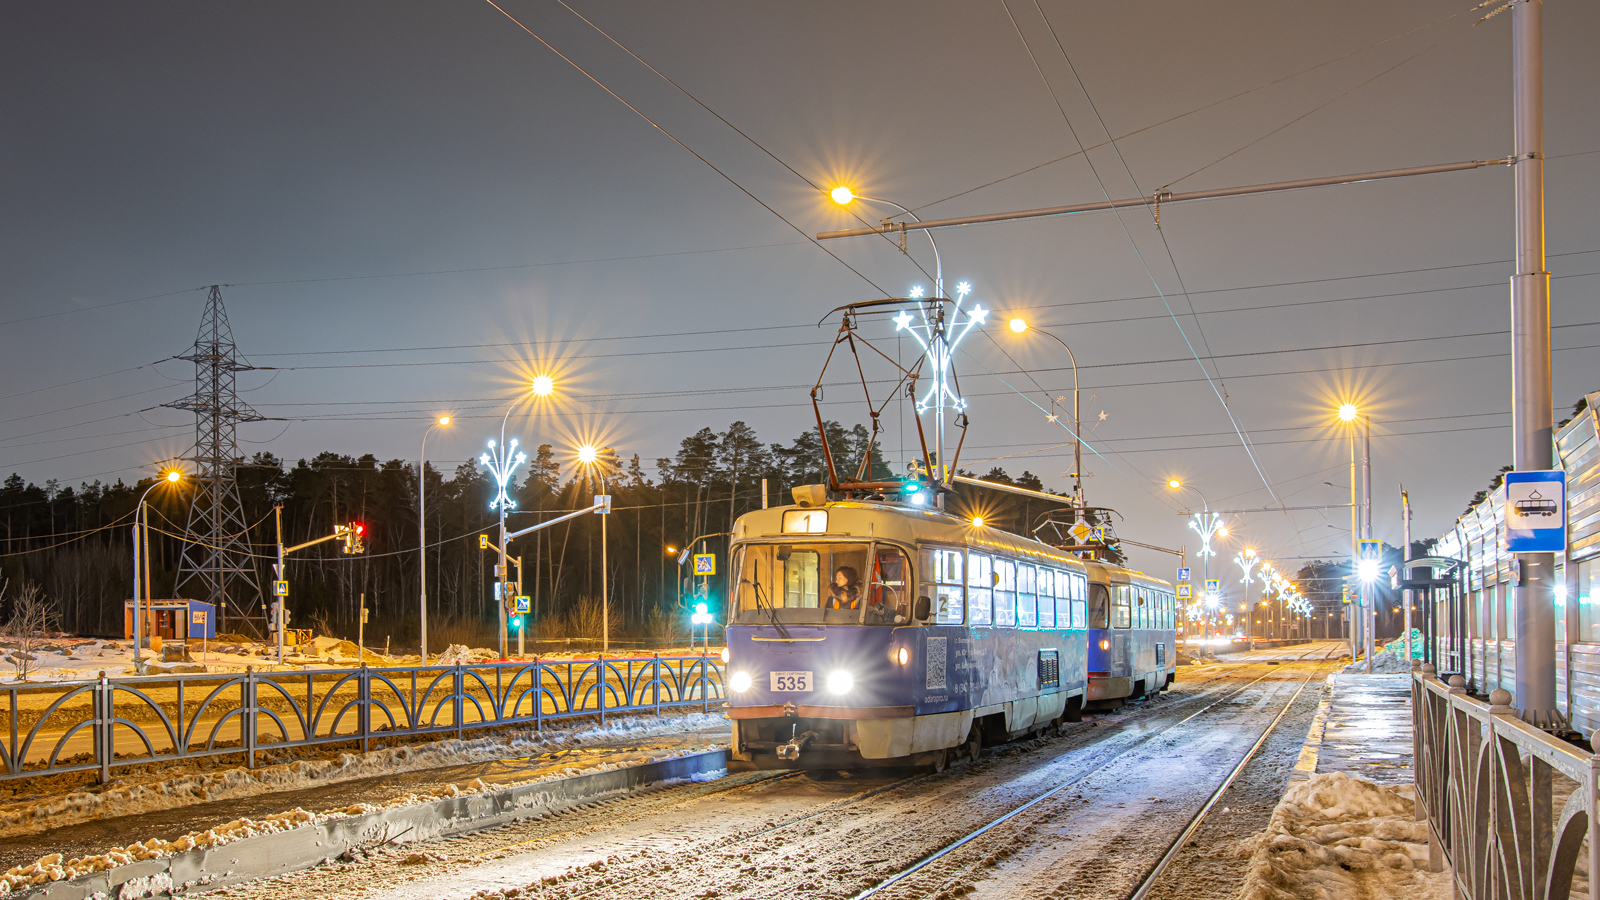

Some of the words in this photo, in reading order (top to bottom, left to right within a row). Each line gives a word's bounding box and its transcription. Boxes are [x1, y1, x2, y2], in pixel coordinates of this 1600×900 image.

[803, 514, 811, 533] 1
[939, 597, 948, 612] 2
[777, 676, 806, 691] 535
